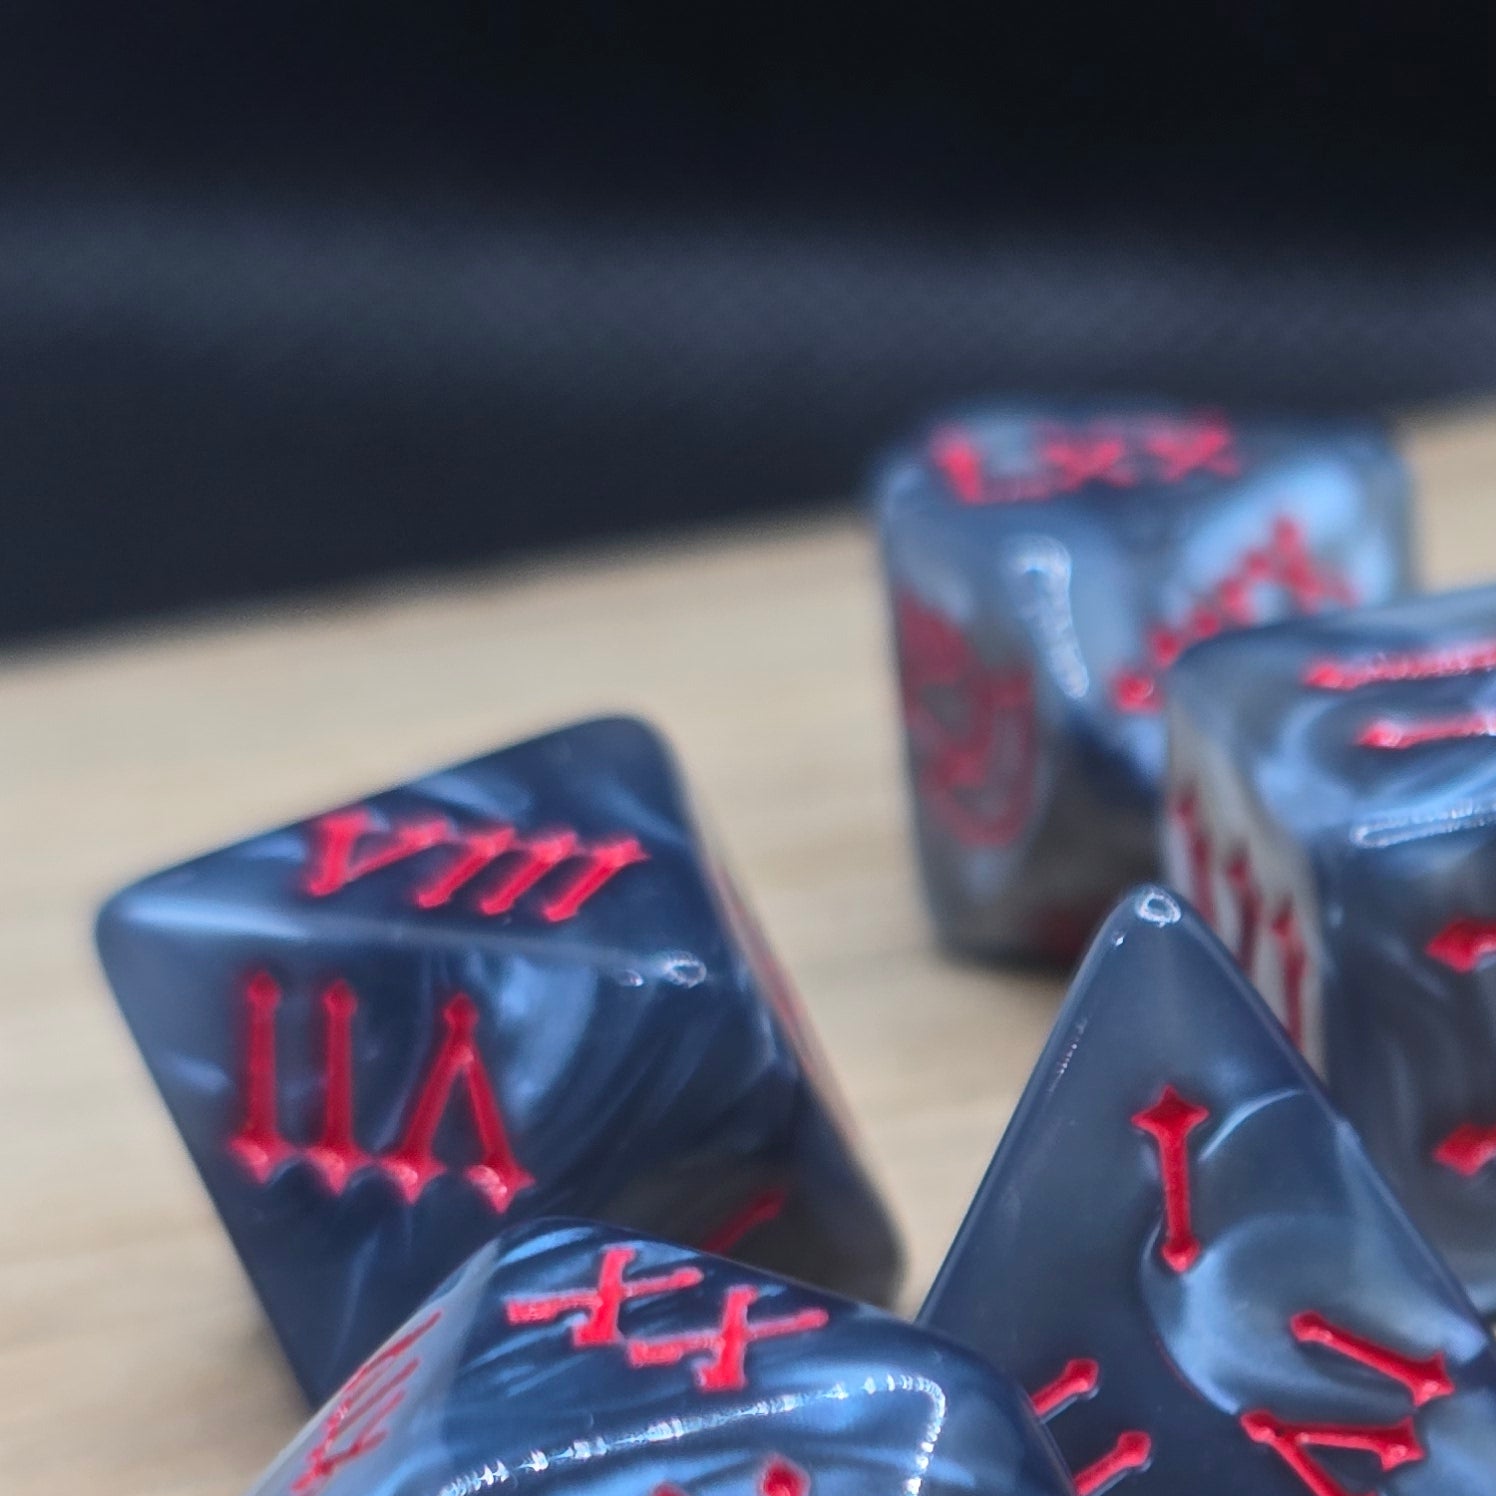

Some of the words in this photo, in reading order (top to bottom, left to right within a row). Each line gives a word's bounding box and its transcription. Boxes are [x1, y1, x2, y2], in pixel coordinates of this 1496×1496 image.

[302, 806, 648, 923] VIII
[1131, 1083, 1210, 1274] I
[505, 1249, 829, 1392] XX
